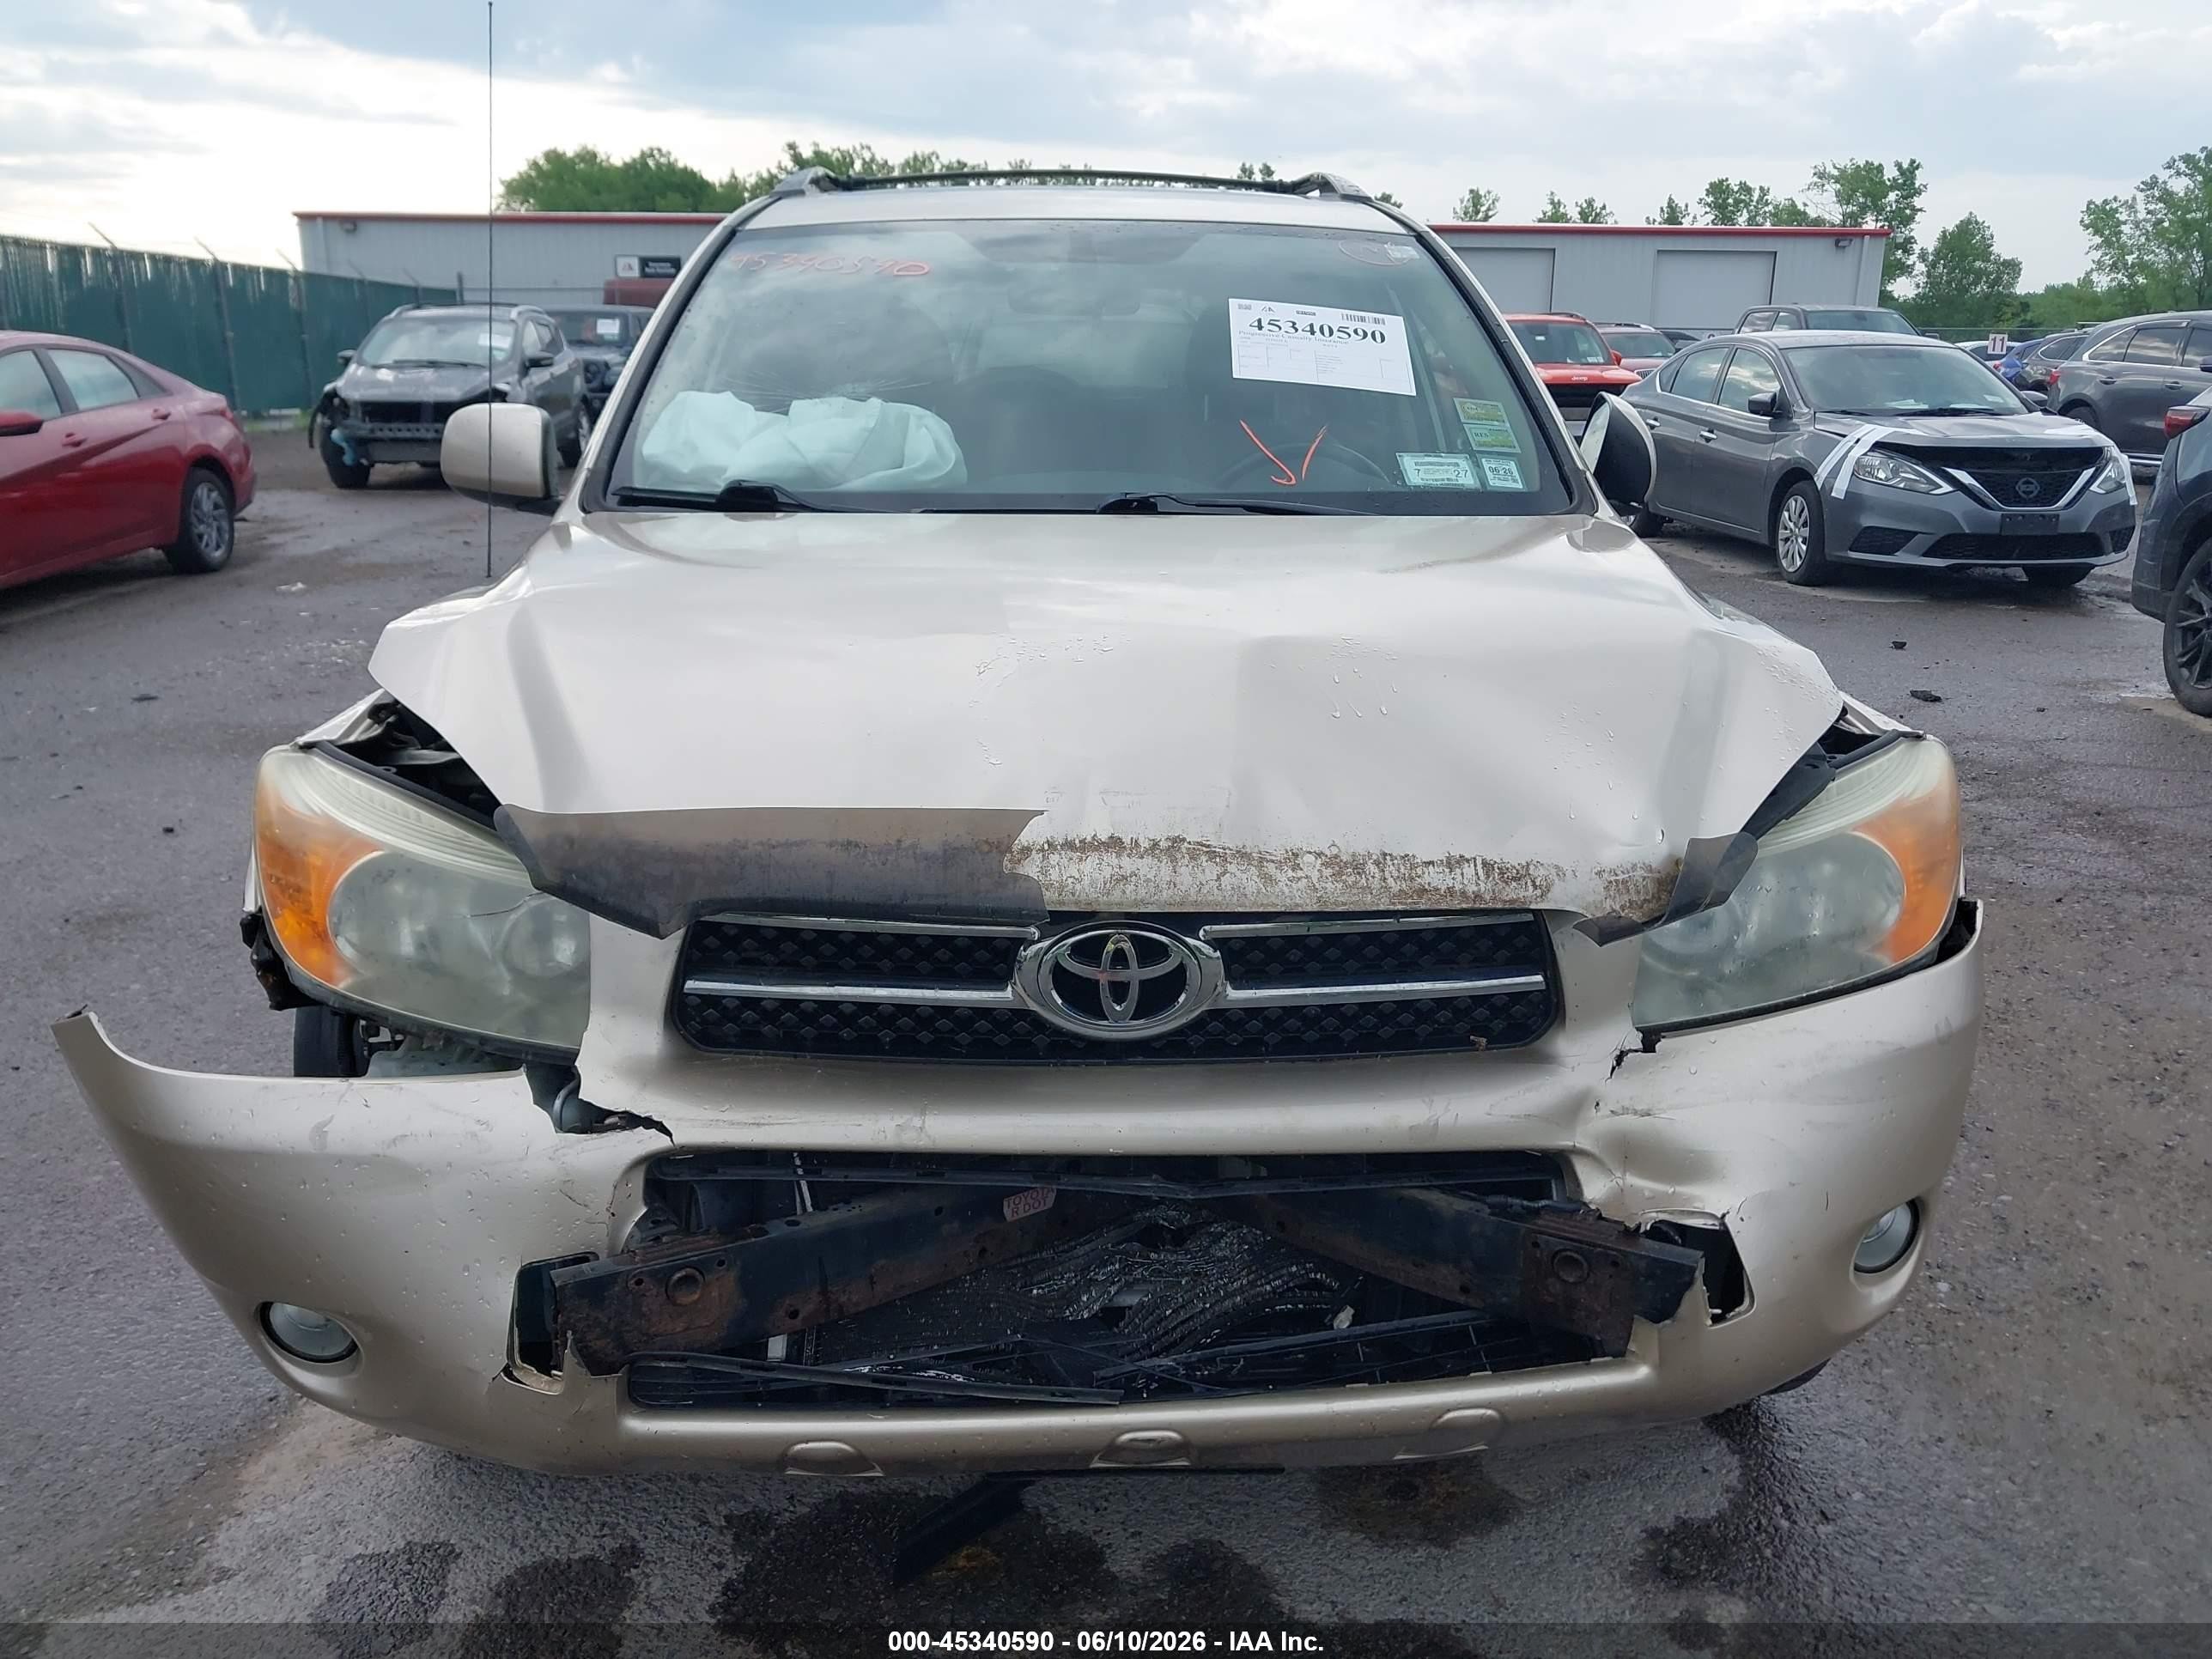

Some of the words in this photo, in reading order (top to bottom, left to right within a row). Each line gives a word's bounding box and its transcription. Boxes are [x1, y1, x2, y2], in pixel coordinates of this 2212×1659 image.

[1249, 318, 1386, 344] 45340590
[1991, 336, 2005, 352] 11
[1454, 469, 1468, 478] 27
